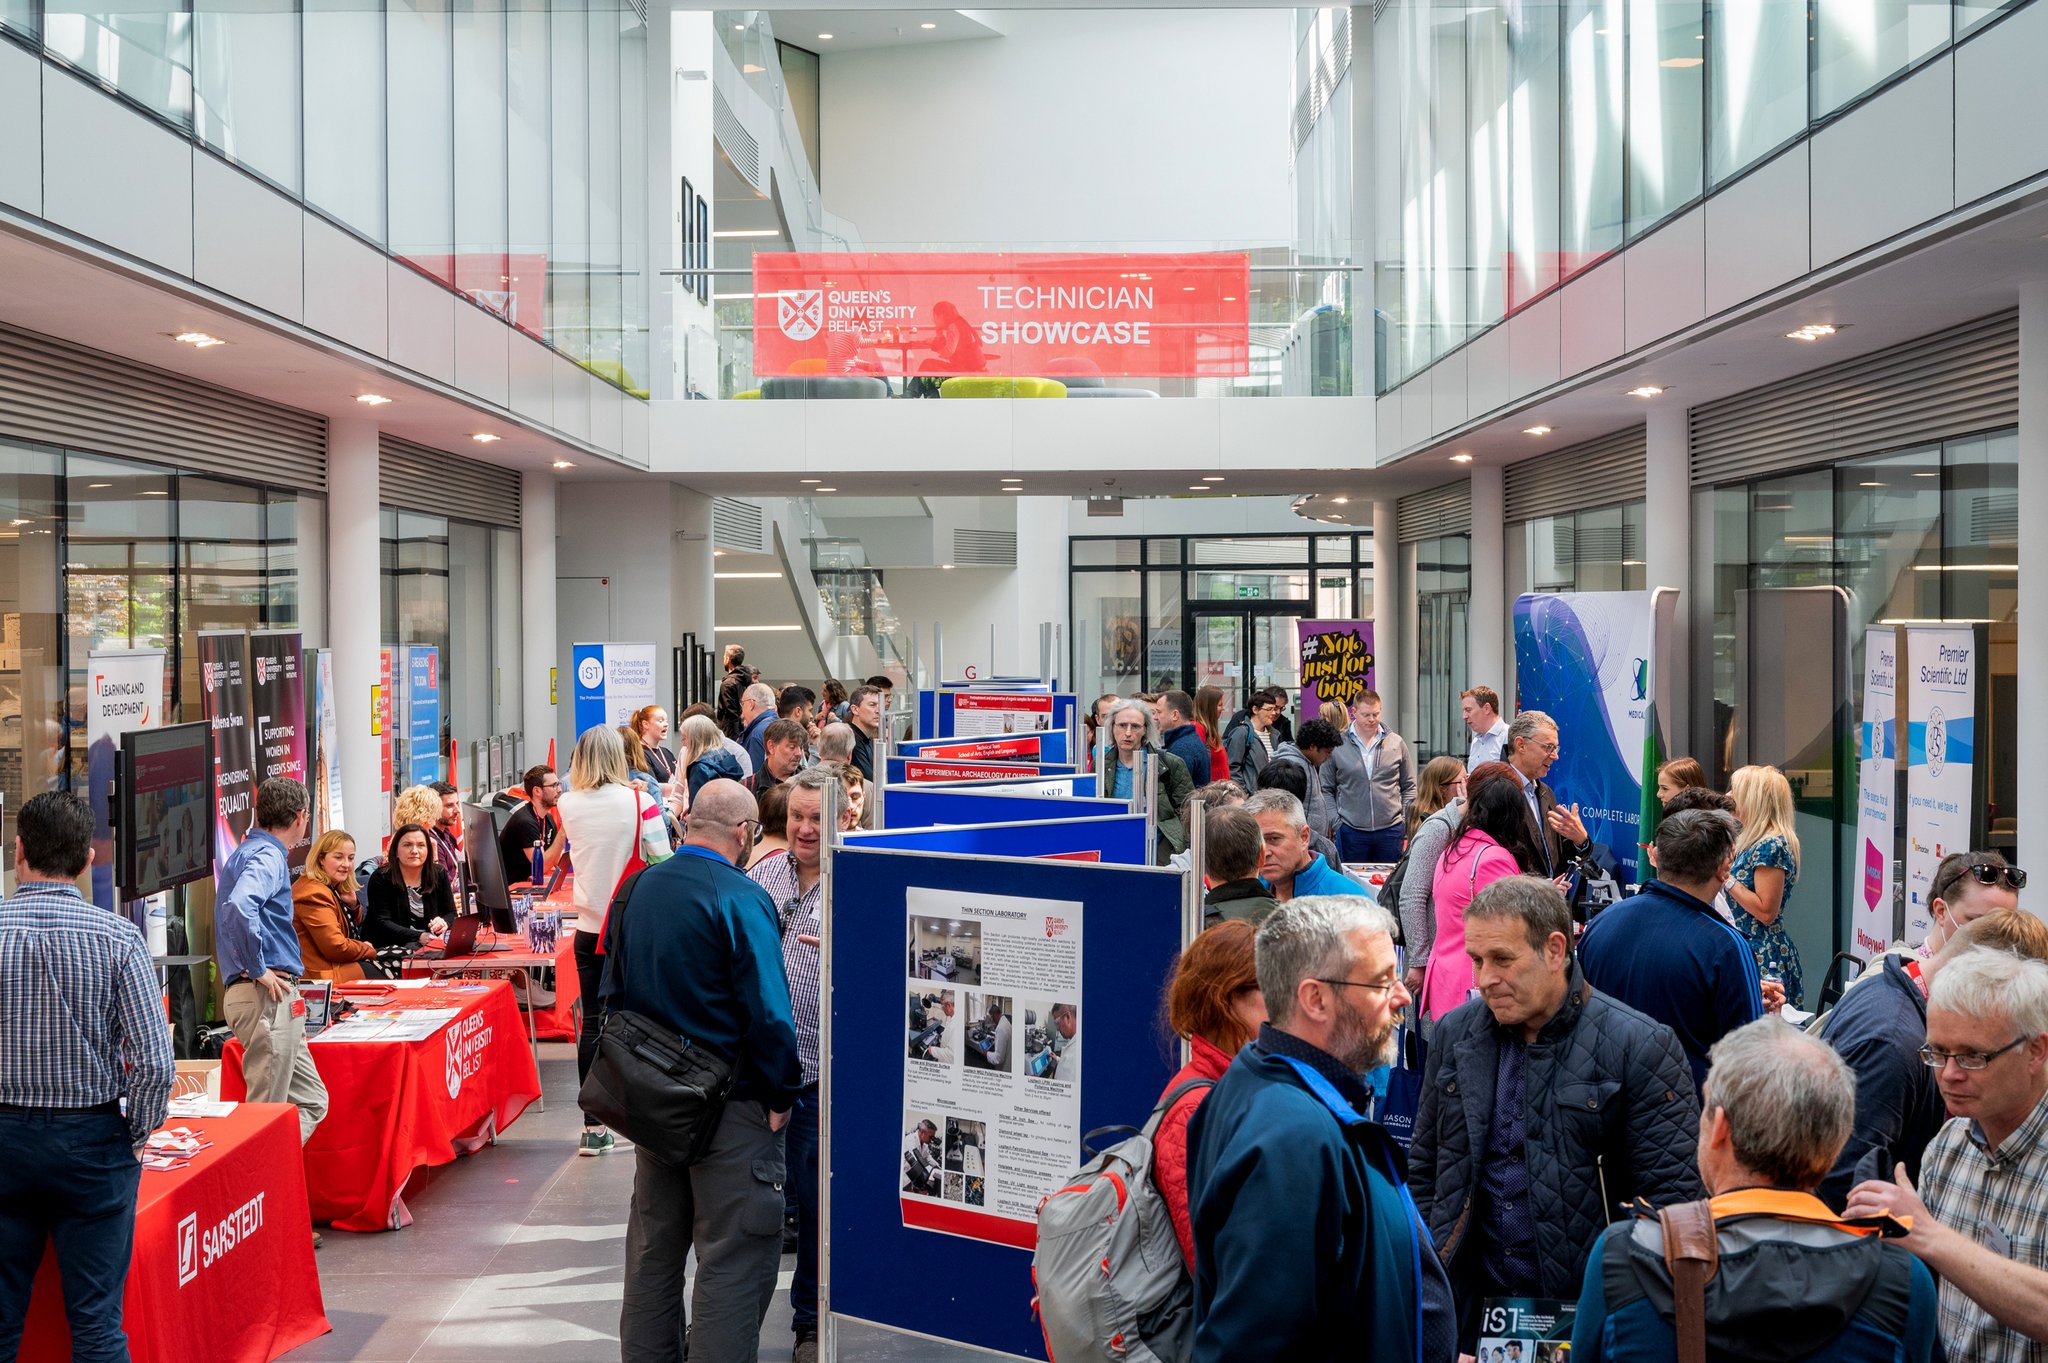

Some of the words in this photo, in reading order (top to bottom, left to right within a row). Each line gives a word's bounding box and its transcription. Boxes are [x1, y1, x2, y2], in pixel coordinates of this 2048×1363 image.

[828, 290, 891, 304] QUEEN'S
[977, 286, 1154, 310] TECHNICIAN
[828, 306, 917, 319] UNIVERSITY
[828, 320, 884, 333] BELFAST
[981, 321, 1151, 345] SHOWCASE
[1880, 651, 1894, 668] Premier
[1939, 645, 1969, 663] Premier
[610, 660, 622, 668] The
[623, 659, 650, 668] Institute
[1302, 656, 1339, 685] just
[1338, 652, 1372, 680] for
[618, 668, 644, 676] Science
[645, 668, 651, 676] &
[965, 665, 977, 680] G
[1920, 665, 1952, 685] Scientific
[1953, 668, 1968, 686] Ltd
[610, 677, 648, 686] Technology
[102, 683, 131, 698] LEARNING
[131, 682, 145, 695] AND
[102, 702, 144, 718] DEVELOPMENT
[212, 714, 230, 731] Athena
[230, 712, 244, 727] Swan
[264, 725, 295, 740] SUPPORTING
[265, 745, 284, 759] WOMEN
[284, 743, 291, 755] IN
[217, 768, 249, 788] ENGENDERING
[266, 761, 286, 780] QUEEN'S
[286, 760, 301, 773] SINCE
[925, 768, 961, 777] EXPERIMENTAL
[962, 770, 1004, 779] ARCHAEOLOGY
[219, 791, 250, 820] EQUALITY
[1912, 797, 1921, 808] you
[1582, 806, 1624, 823] COMPLETE
[961, 906, 973, 914] THIN
[973, 908, 994, 917] SECTION
[994, 910, 1027, 920] LABORATORY
[1857, 927, 1886, 956] Honeywell
[202, 1191, 265, 1269] SARSTEDT
[1482, 1307, 1522, 1334] iST
